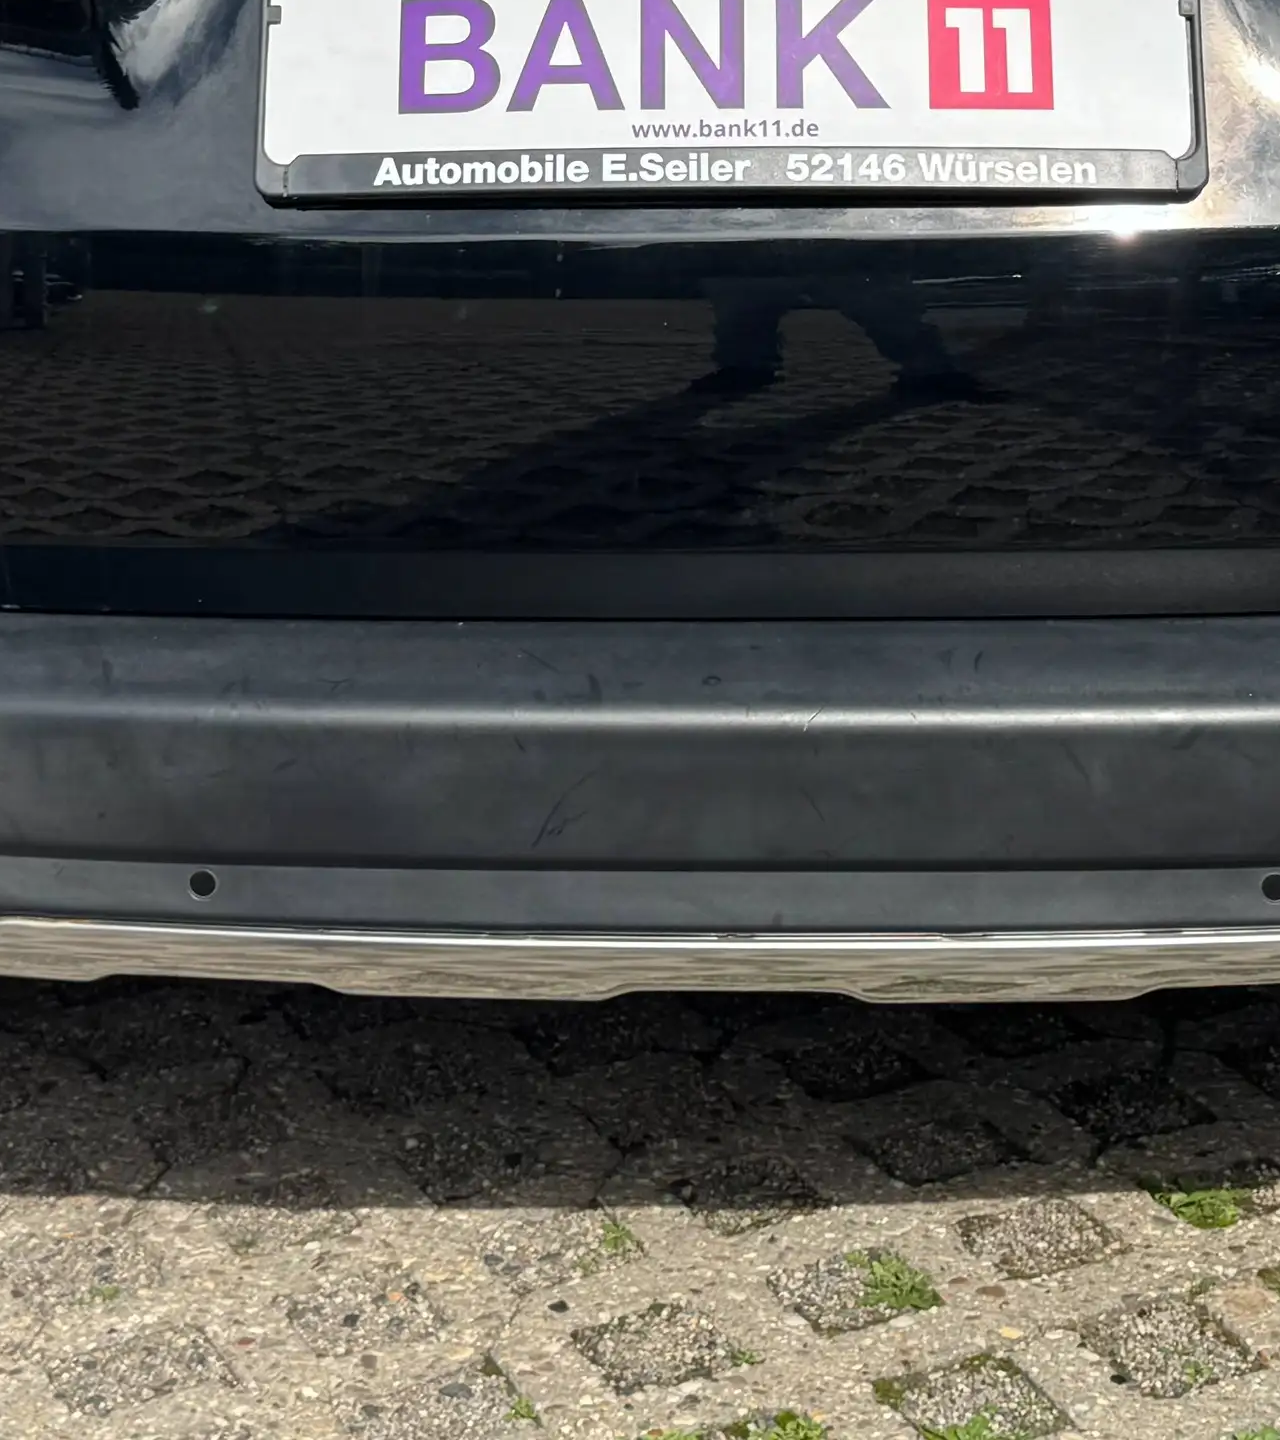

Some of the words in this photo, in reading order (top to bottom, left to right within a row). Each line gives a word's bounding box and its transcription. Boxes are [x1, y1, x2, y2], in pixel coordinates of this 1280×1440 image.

[935, 0, 1047, 103] 11
[631, 118, 820, 139] www.bank11.de
[373, 155, 590, 186] Automobile
[601, 152, 752, 184] E.Seiler
[785, 153, 907, 183] 52146
[917, 152, 1098, 184] Würselen
